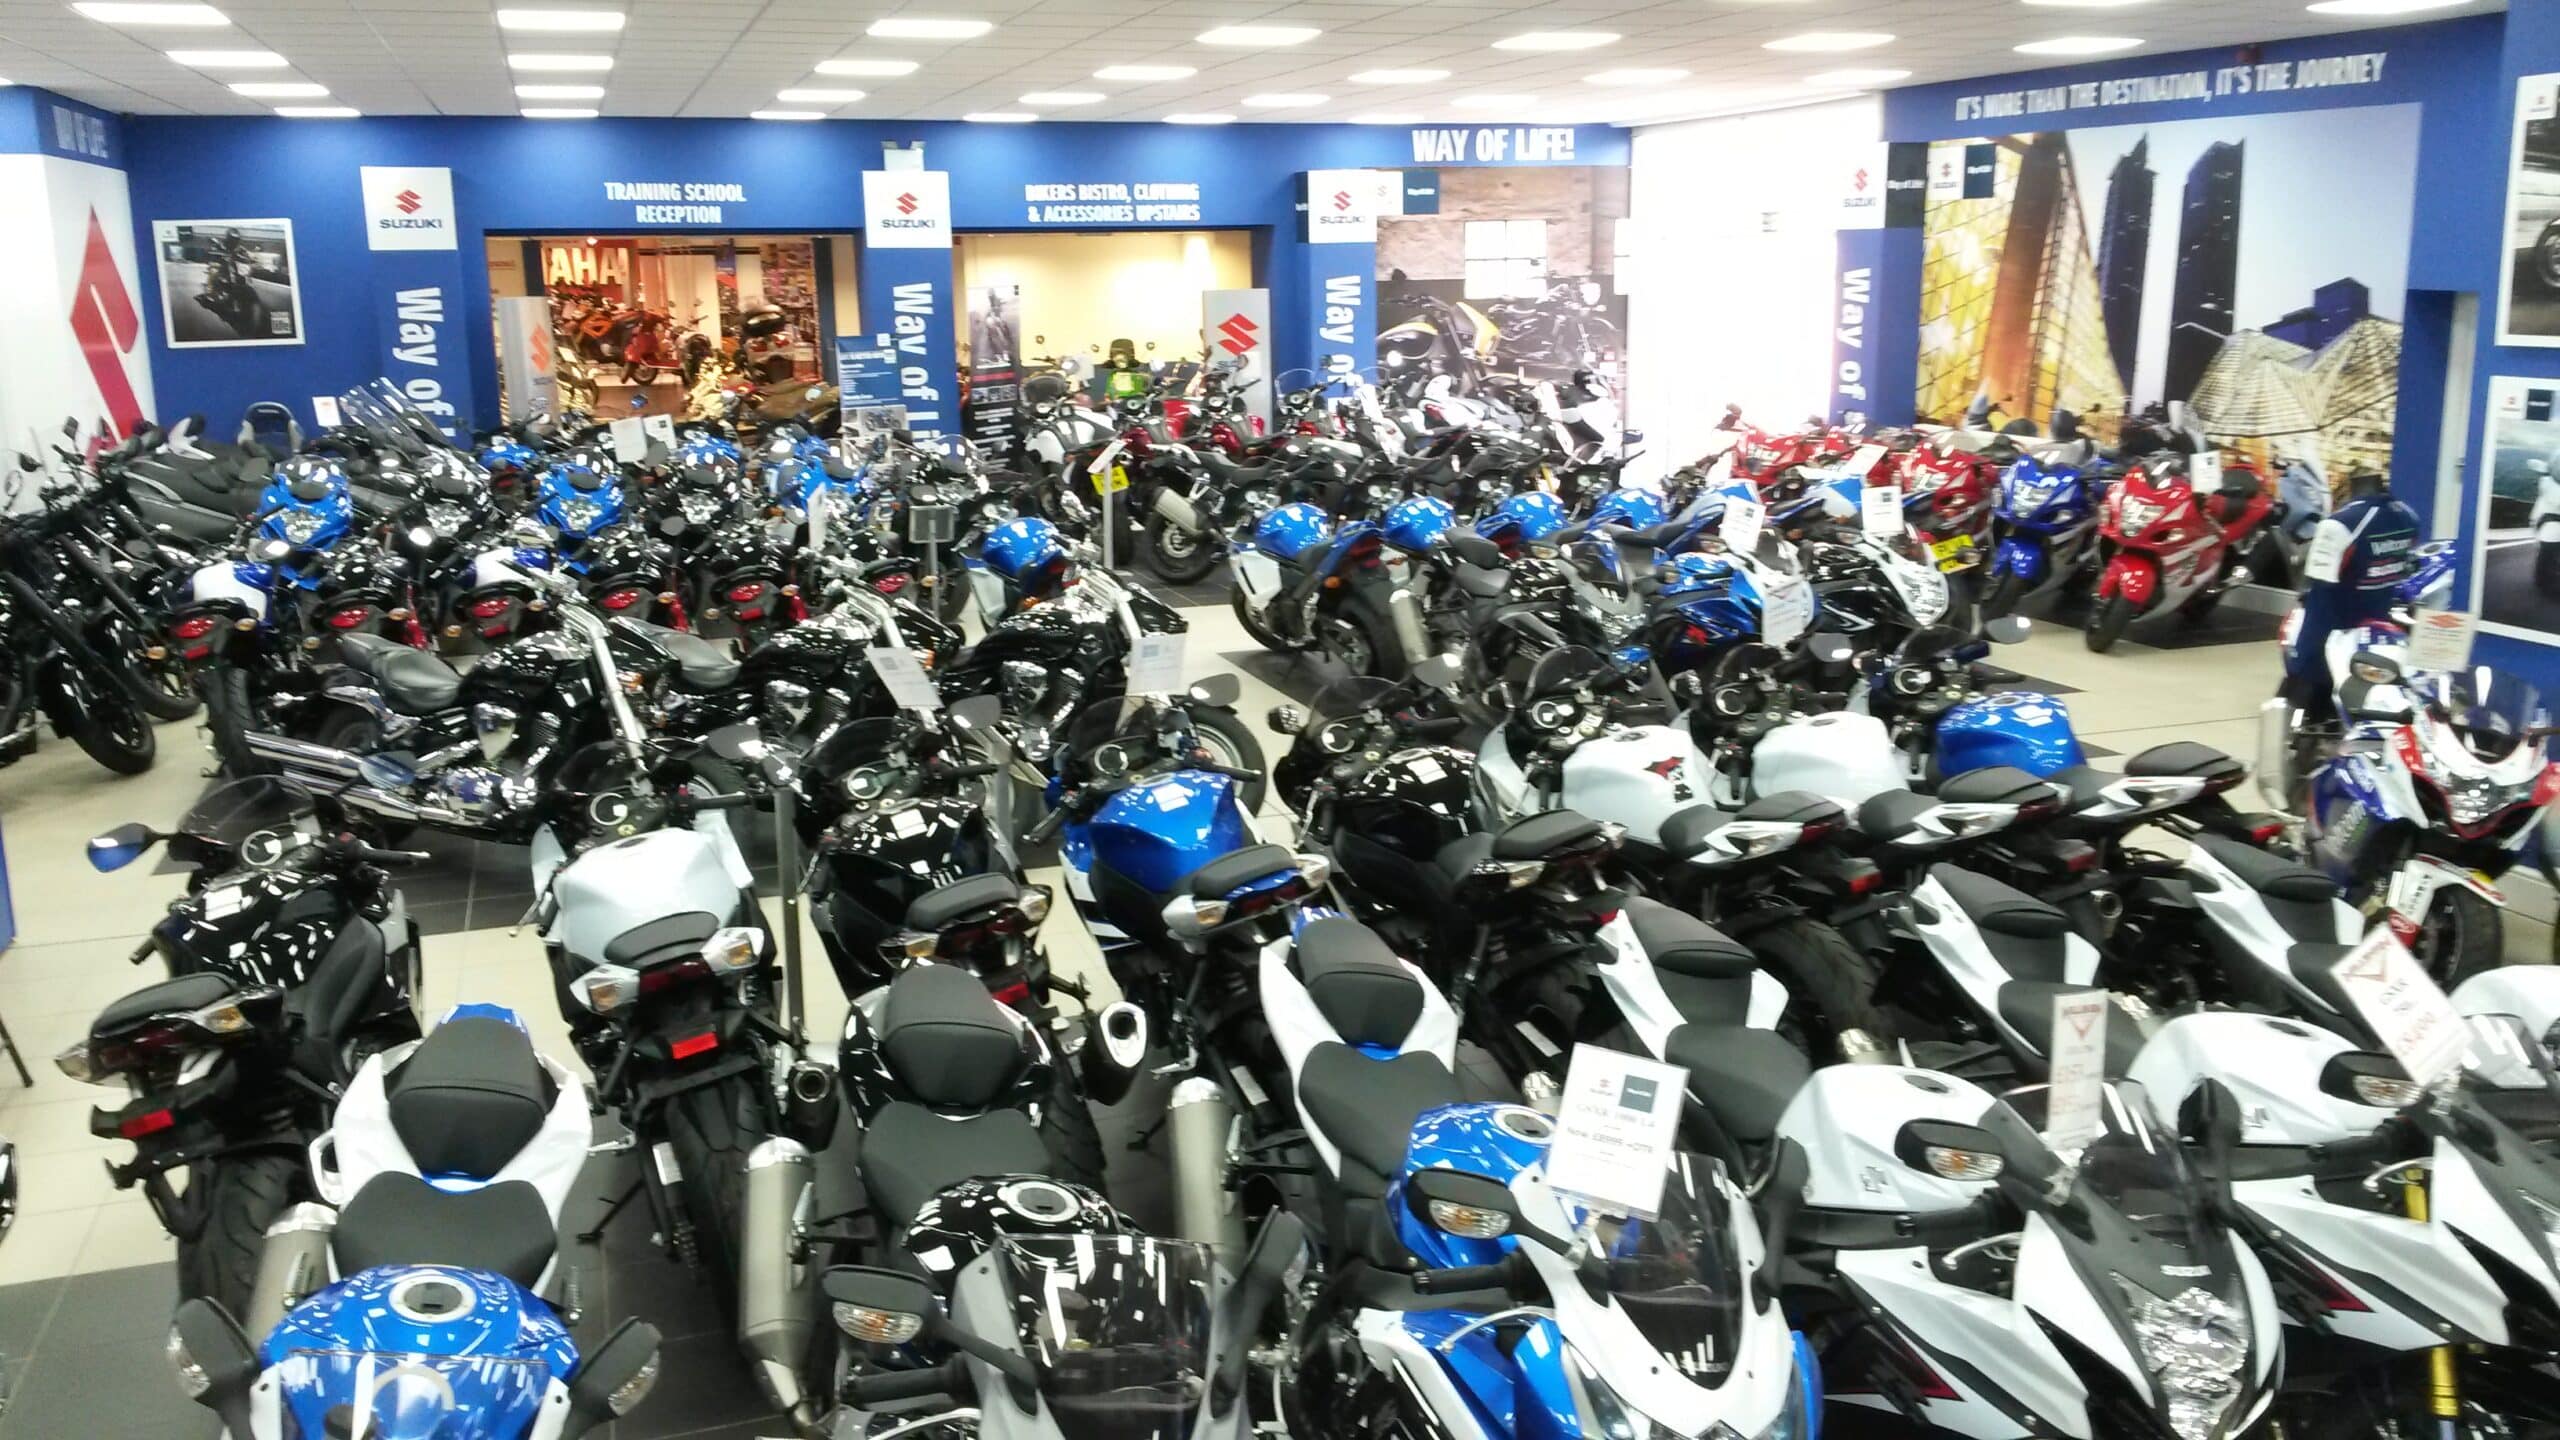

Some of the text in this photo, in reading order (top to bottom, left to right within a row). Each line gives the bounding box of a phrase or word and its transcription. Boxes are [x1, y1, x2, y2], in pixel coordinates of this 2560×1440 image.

[2068, 82, 2099, 109] THE
[2215, 65, 2252, 96] IT'S
[2254, 61, 2293, 92] THE
[2293, 52, 2388, 89] JOURNEY
[1411, 127, 1576, 162] WAY OF LIFE!
[603, 182, 748, 202] TRAINING SCHOOL
[1025, 183, 1200, 204] BIKERS BISTRO, CLOTHING
[379, 218, 443, 230] SUZUKI
[635, 204, 722, 223] RECEPTION
[881, 218, 936, 229] SUZUKI
[1027, 204, 1200, 223] & ACCESSORIES UPSTAIRS
[1319, 215, 1366, 225] SUZUKI
[892, 282, 935, 356] Way
[1319, 275, 1362, 345] Way
[1836, 267, 1872, 349] Way
[392, 286, 456, 416] Way of
[900, 366, 940, 401] of
[1838, 360, 1867, 401] of
